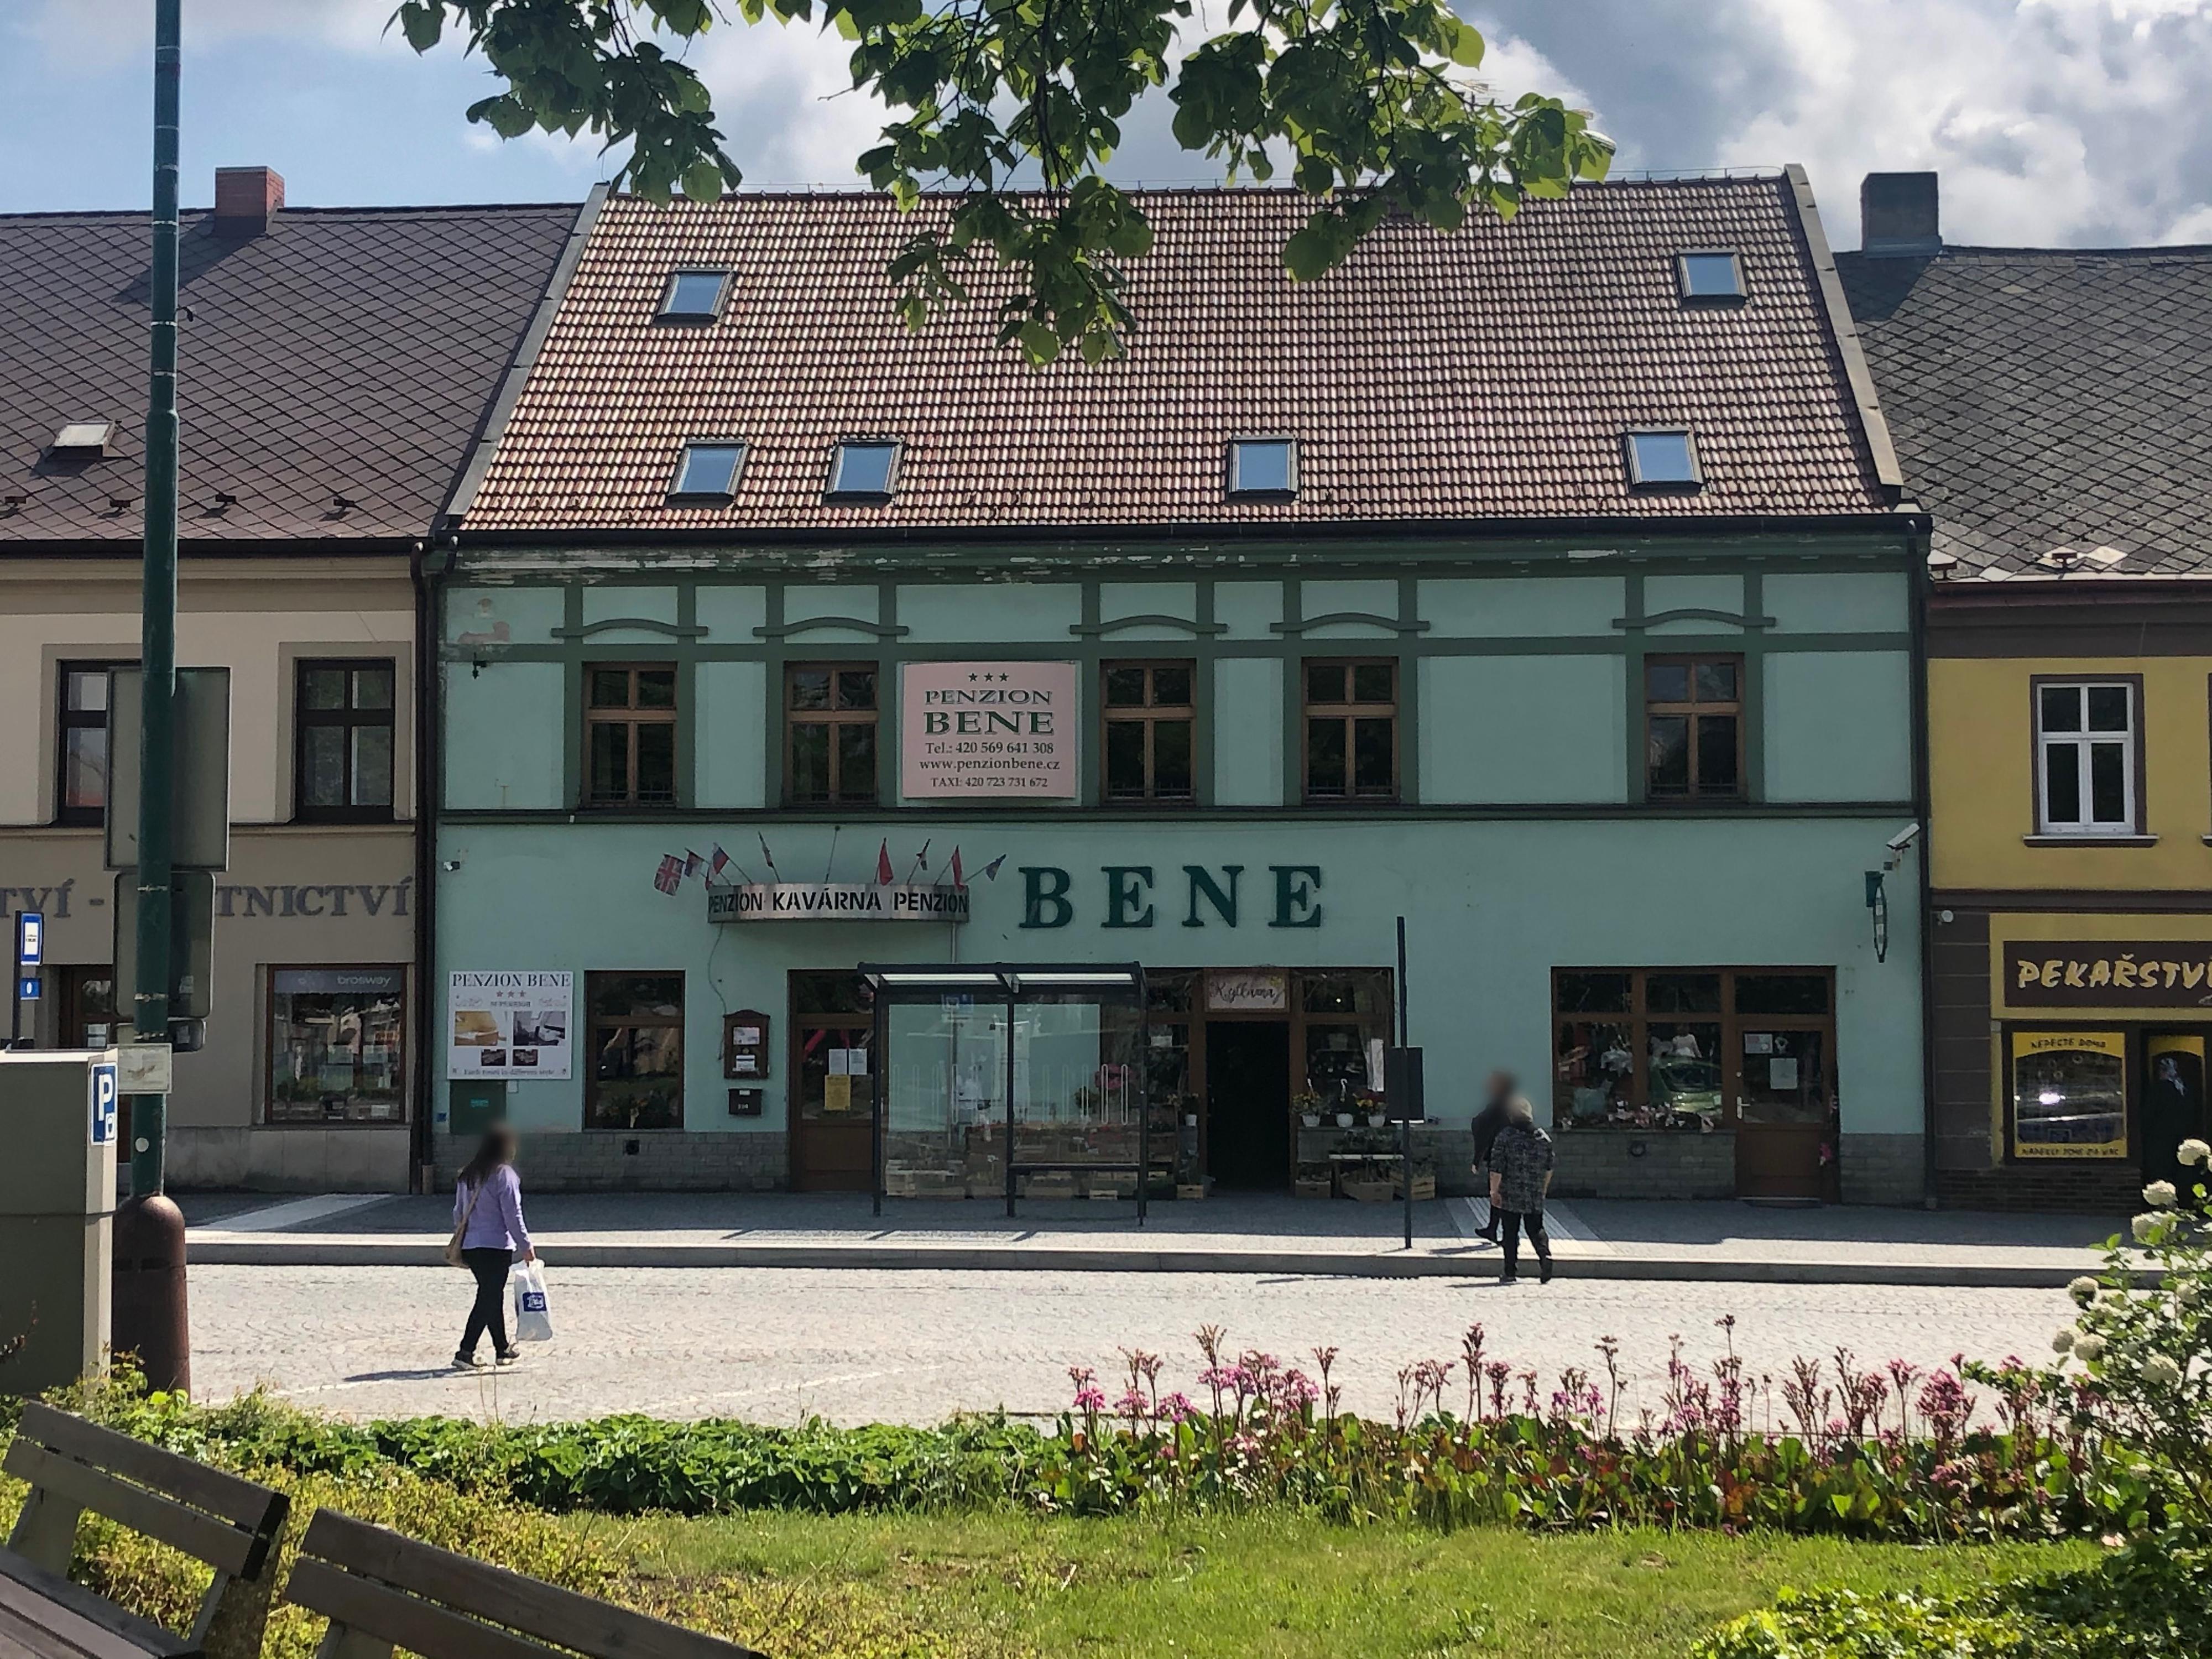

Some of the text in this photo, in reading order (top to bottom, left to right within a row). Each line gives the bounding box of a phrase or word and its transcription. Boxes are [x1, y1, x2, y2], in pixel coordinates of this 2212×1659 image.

[925, 690, 1052, 705] PENZION
[924, 711, 1054, 735] BENE
[956, 743, 977, 753] 420
[980, 743, 1003, 753] 569
[1006, 743, 1027, 753] 641
[1032, 743, 1054, 754] 308
[920, 758, 1060, 773] www.penzionbene.cz
[931, 778, 1048, 787] TAXI: 420 723 731 672
[708, 888, 968, 914] PENZION KAVÁRNA PENZION
[1018, 865, 1322, 928] BENE
[453, 974, 571, 987] PENZION BENE
[98, 1074, 113, 1121] P
